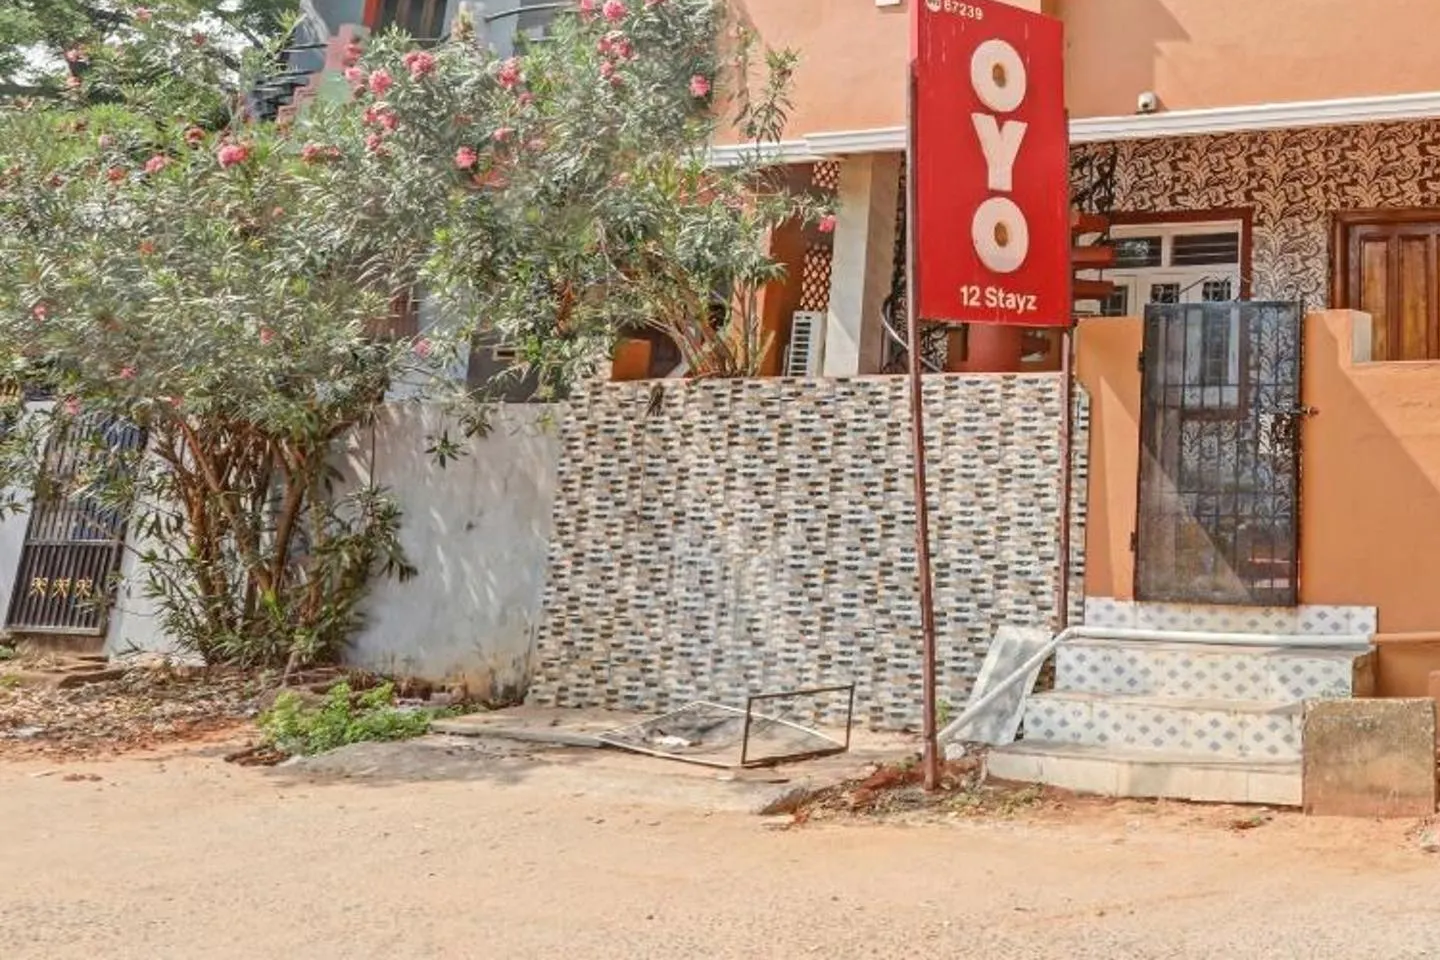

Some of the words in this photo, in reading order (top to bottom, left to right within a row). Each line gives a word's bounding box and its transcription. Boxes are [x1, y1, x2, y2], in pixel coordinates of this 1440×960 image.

[970, 38, 1030, 274] OYO
[960, 285, 981, 307] 12
[984, 286, 1038, 314] Stayz
